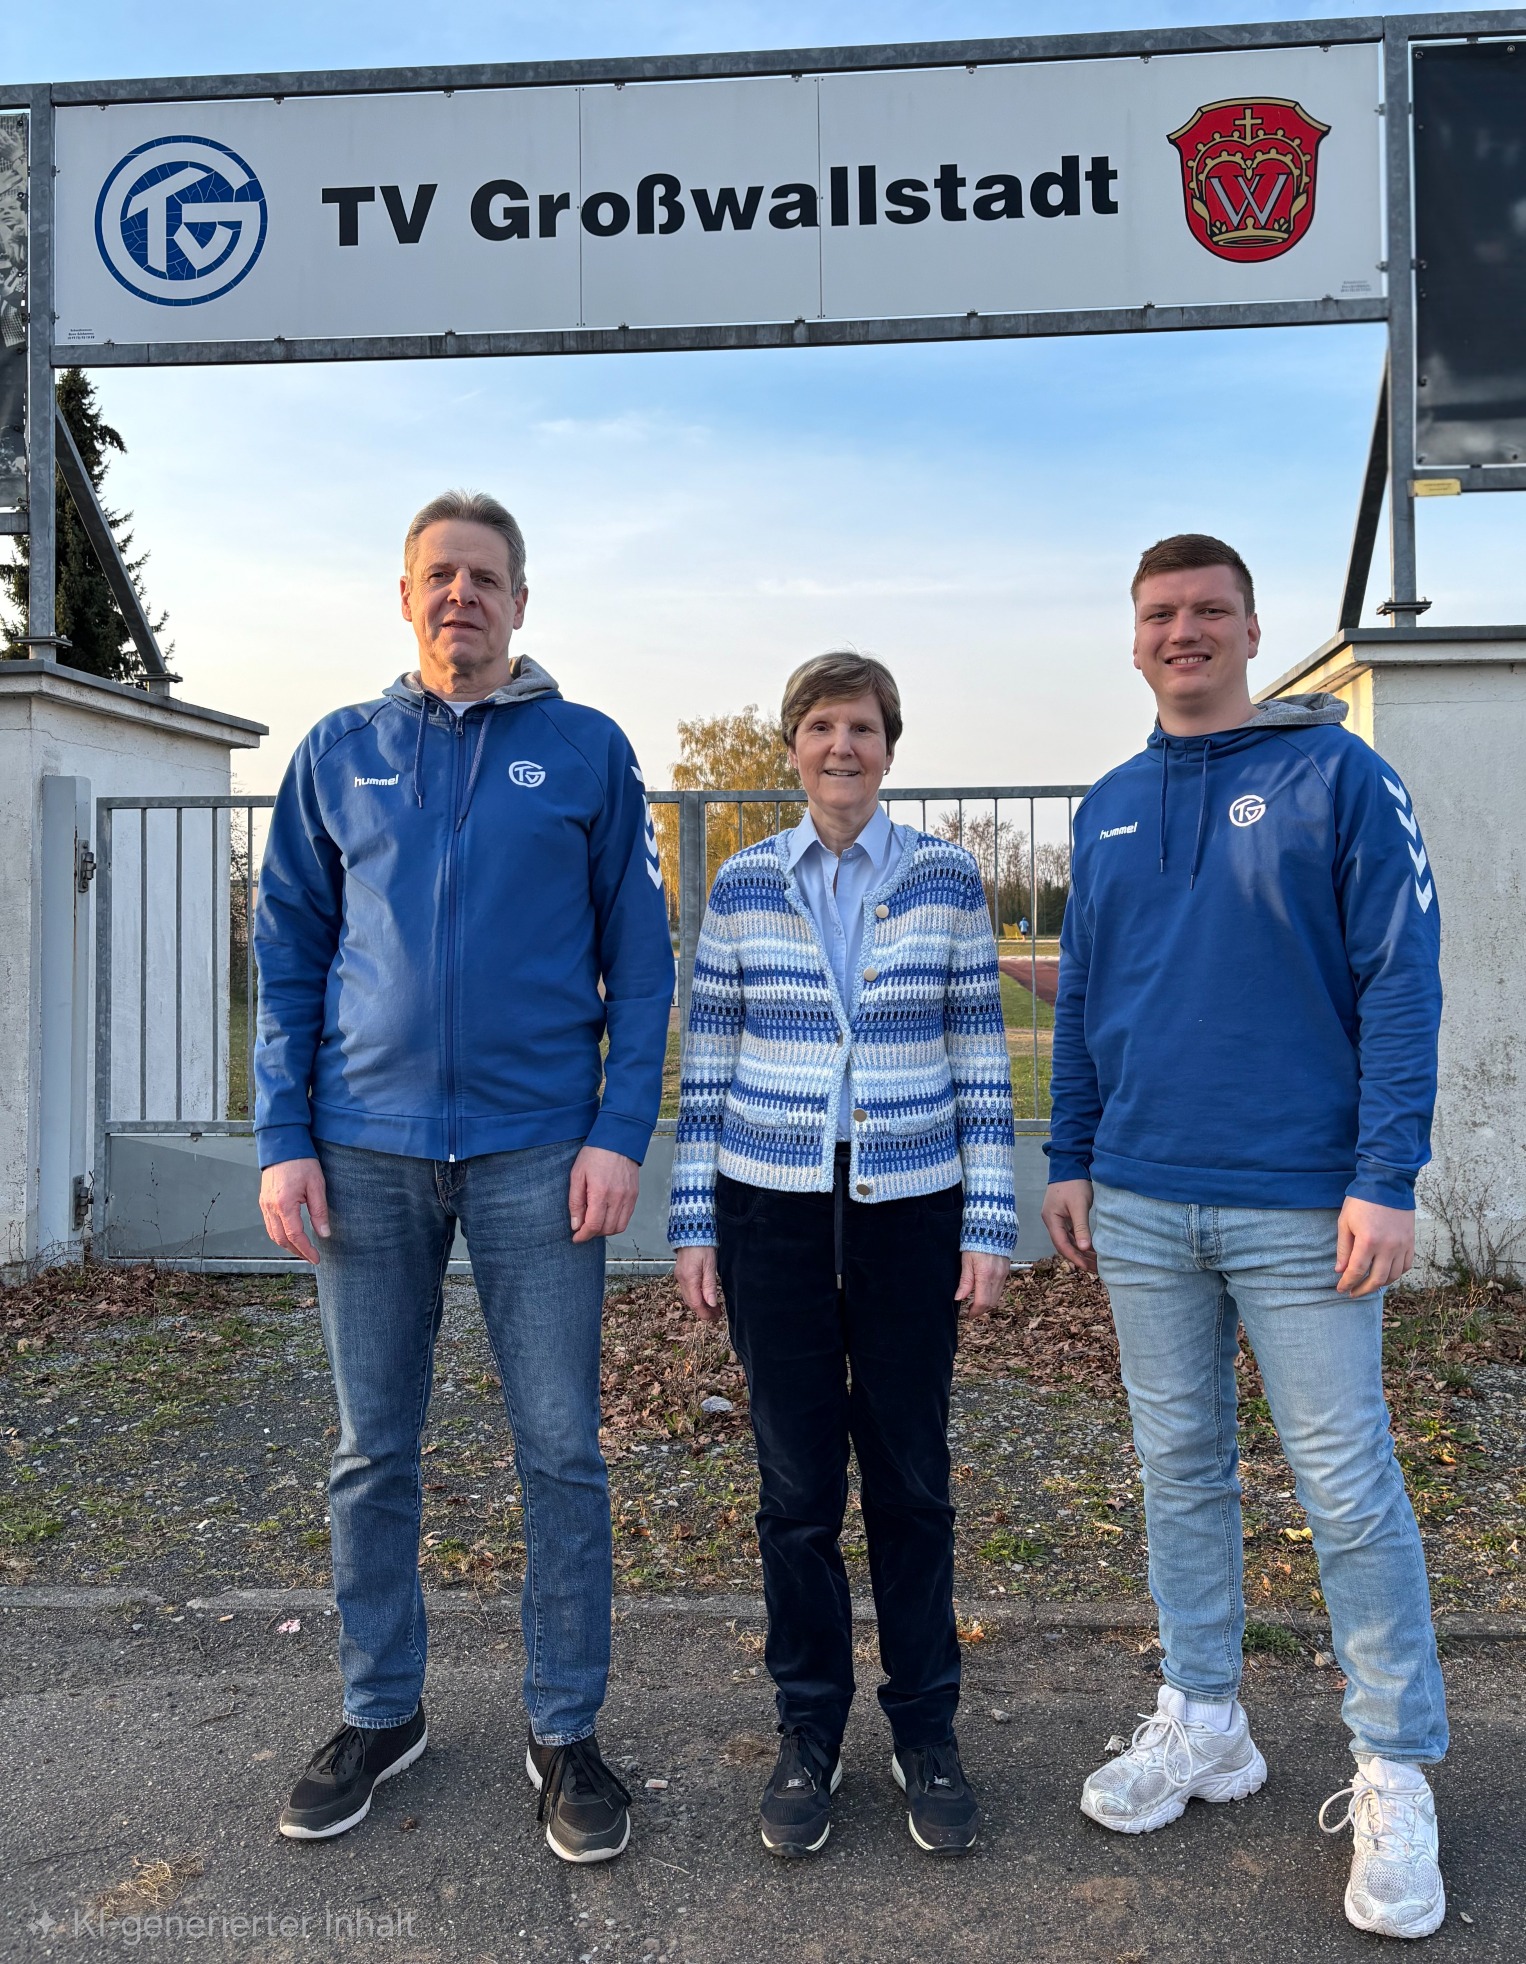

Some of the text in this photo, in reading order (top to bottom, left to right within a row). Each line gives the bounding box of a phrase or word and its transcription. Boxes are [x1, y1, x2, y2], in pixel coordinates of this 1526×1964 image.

[321, 154, 1119, 247] TV Großwallstadt
[354, 774, 399, 788] hummel
[1099, 821, 1138, 840] hummel
